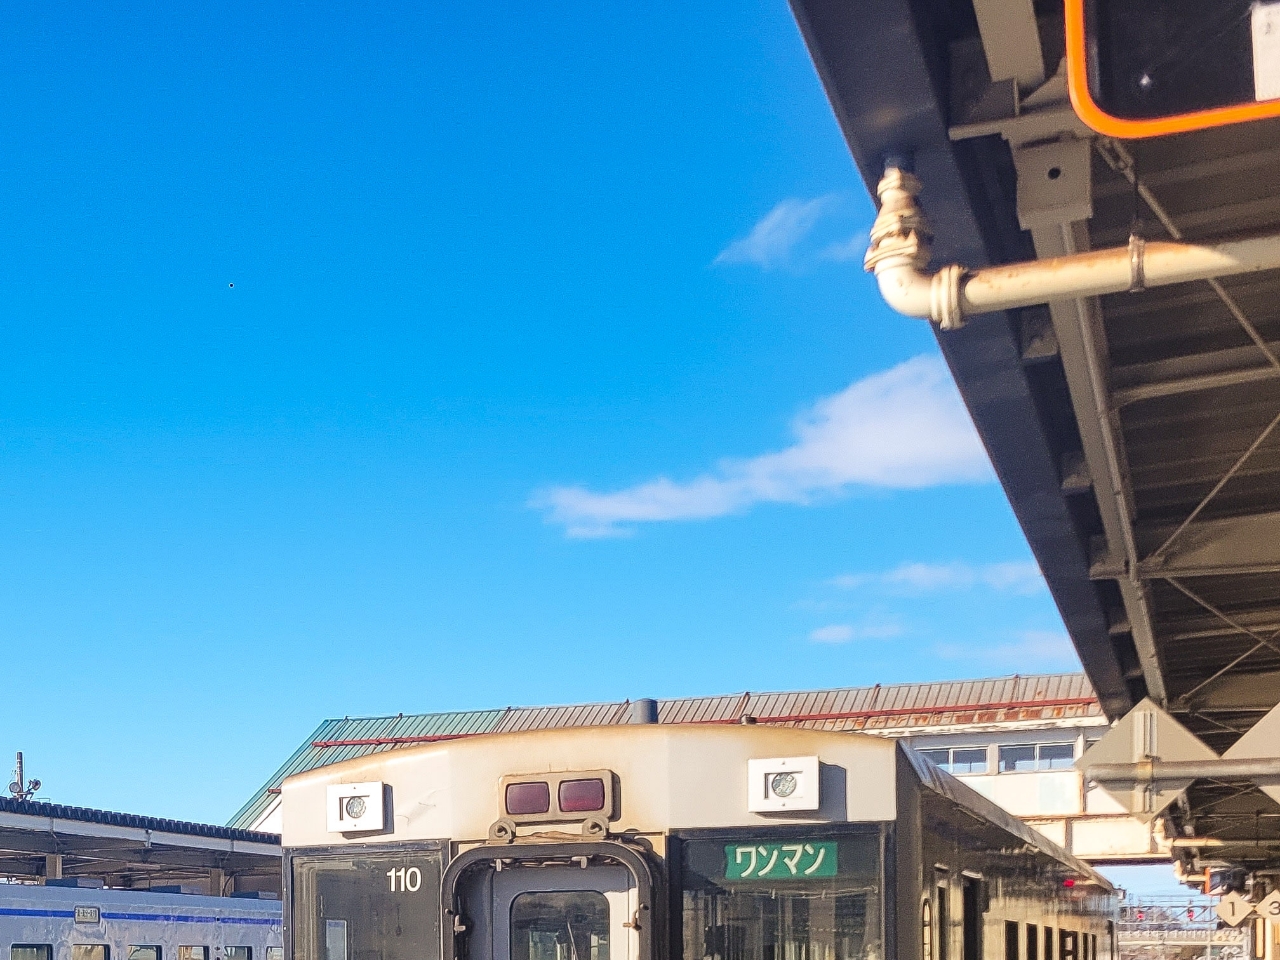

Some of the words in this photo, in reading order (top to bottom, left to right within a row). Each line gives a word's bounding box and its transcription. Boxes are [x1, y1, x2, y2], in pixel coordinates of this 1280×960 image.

[735, 844, 826, 877] ワンマン
[386, 867, 422, 893] 110
[1228, 901, 1236, 917] 1
[1269, 900, 1280, 916] 3
